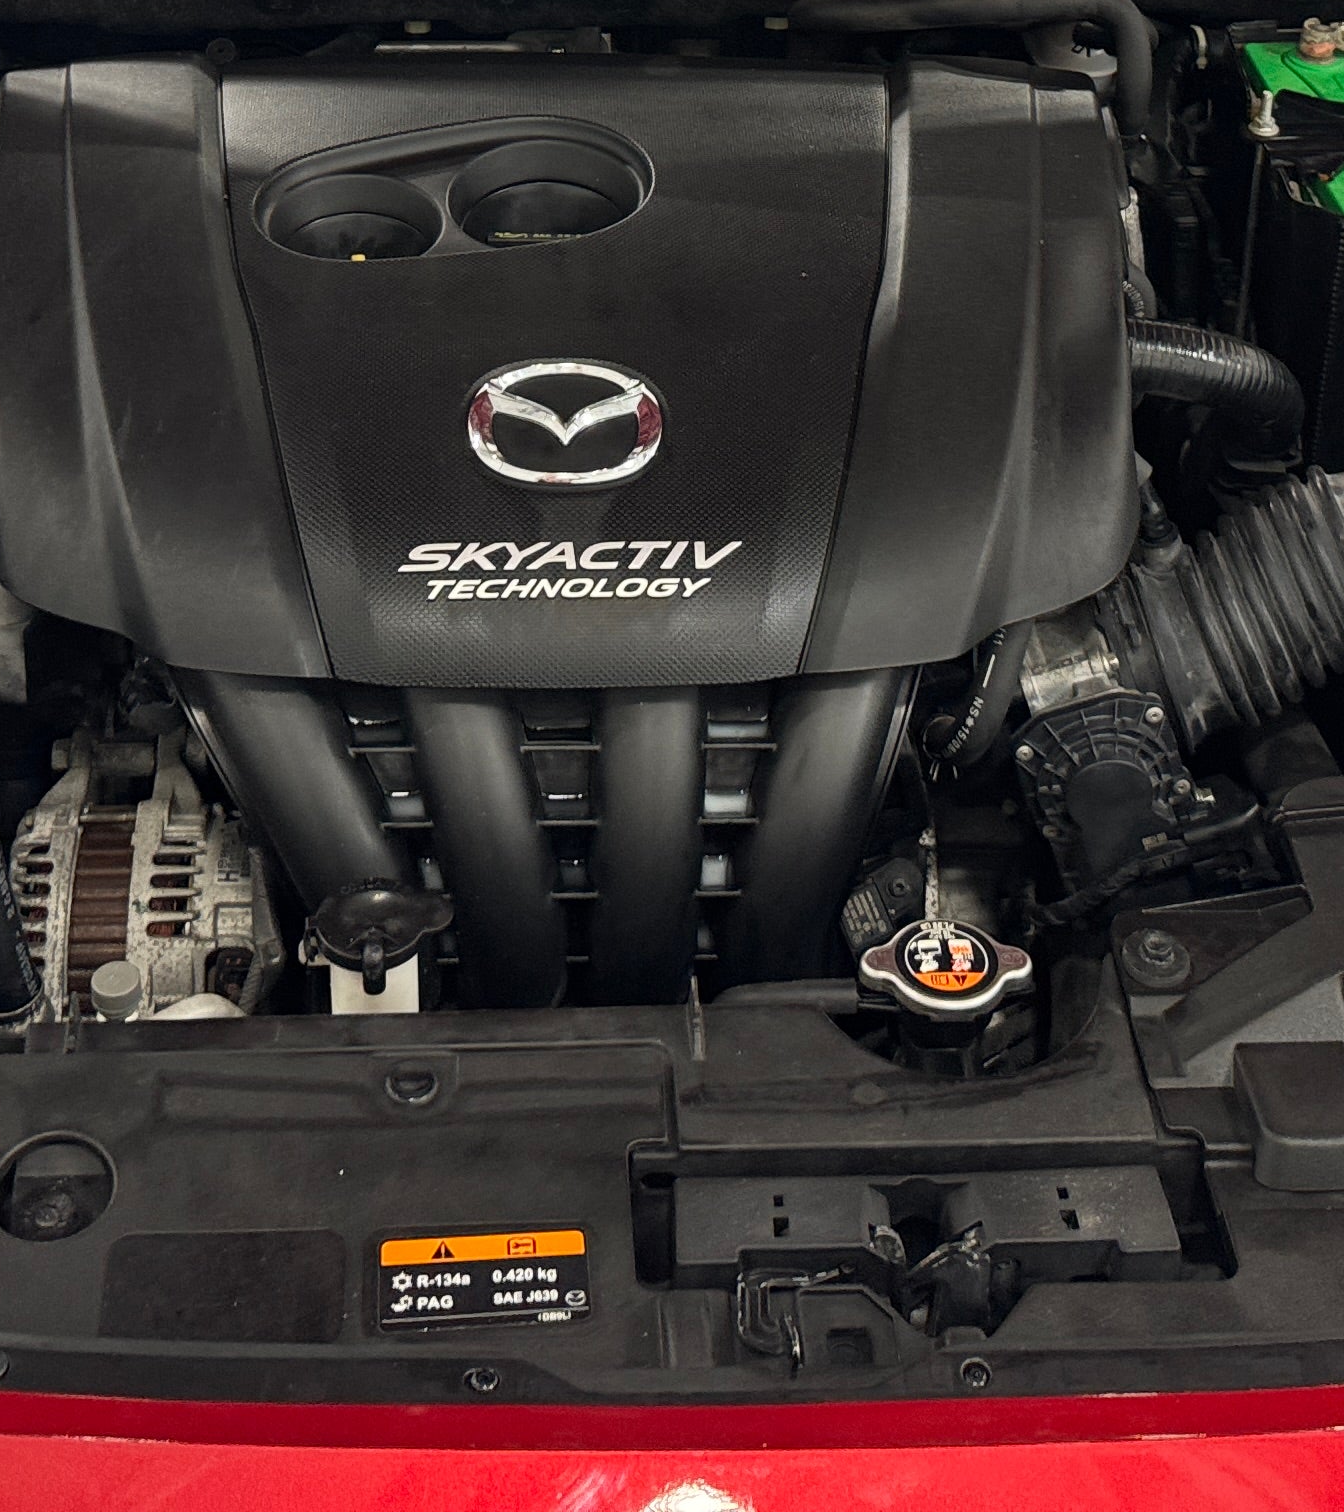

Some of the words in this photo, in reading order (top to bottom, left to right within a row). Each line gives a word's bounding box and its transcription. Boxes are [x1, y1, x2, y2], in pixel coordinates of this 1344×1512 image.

[397, 540, 743, 573] SKYACTIV
[426, 577, 712, 602] TECHNOLOGY
[416, 1272, 471, 1288] R-134a
[492, 1267, 534, 1284] 0.420
[537, 1266, 558, 1284] kg
[417, 1295, 454, 1311] PAG
[493, 1291, 524, 1306] SAE
